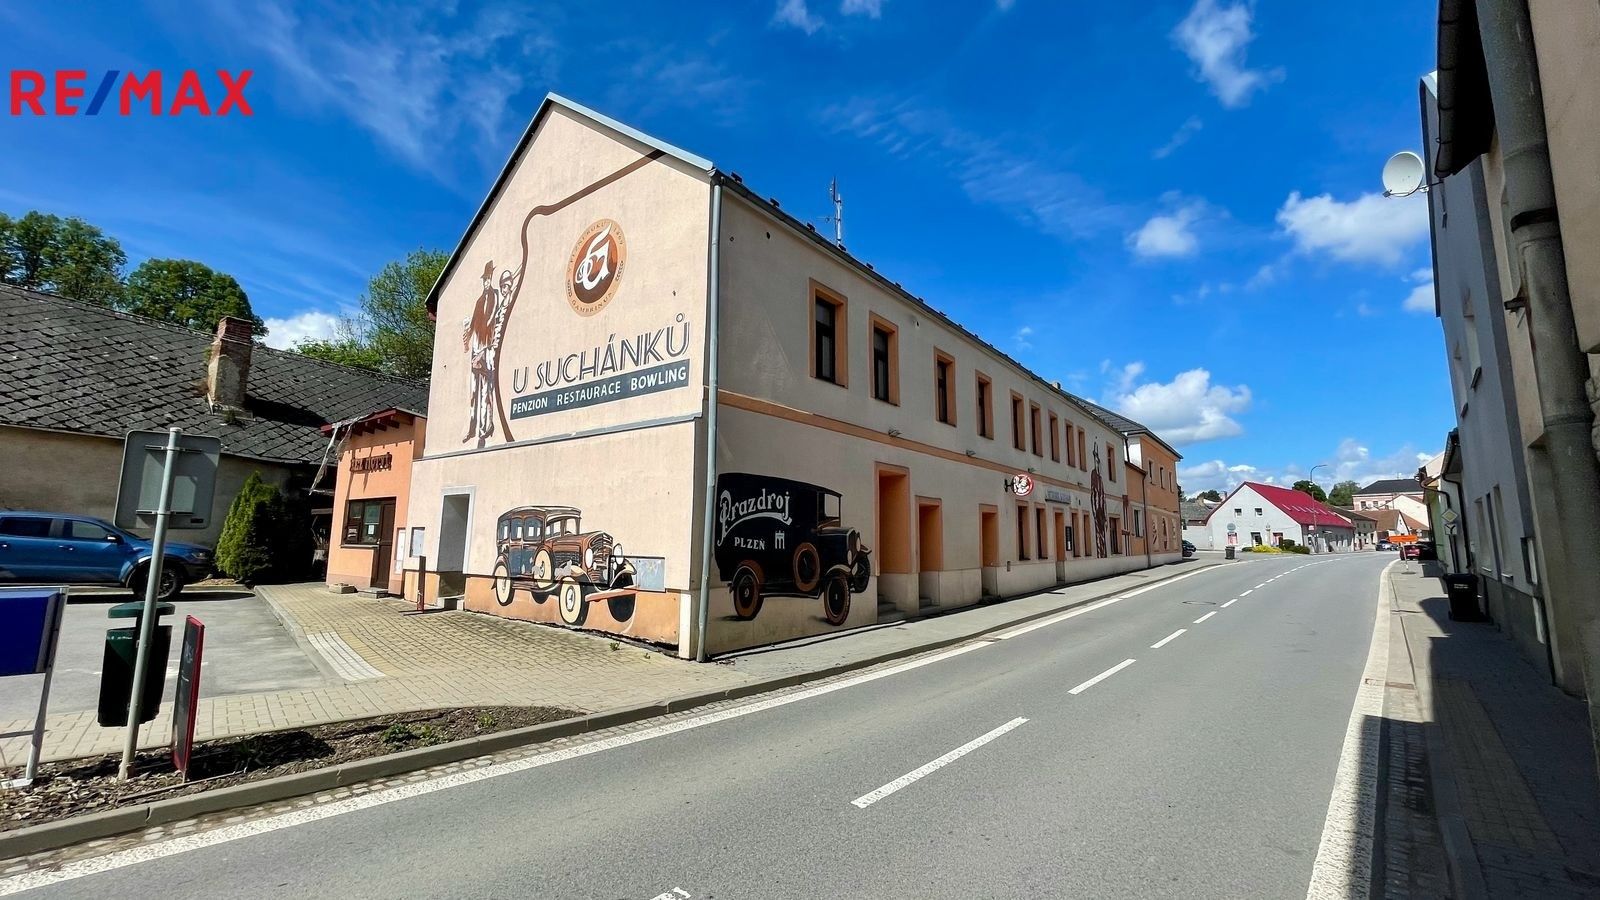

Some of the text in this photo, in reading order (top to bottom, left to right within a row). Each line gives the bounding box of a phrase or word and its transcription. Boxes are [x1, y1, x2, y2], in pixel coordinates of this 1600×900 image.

[513, 313, 690, 394] U SUCHÁNKŮ
[512, 366, 687, 414] PENZION RESTAURACE BOWLING
[717, 488, 791, 546] Prazdroj
